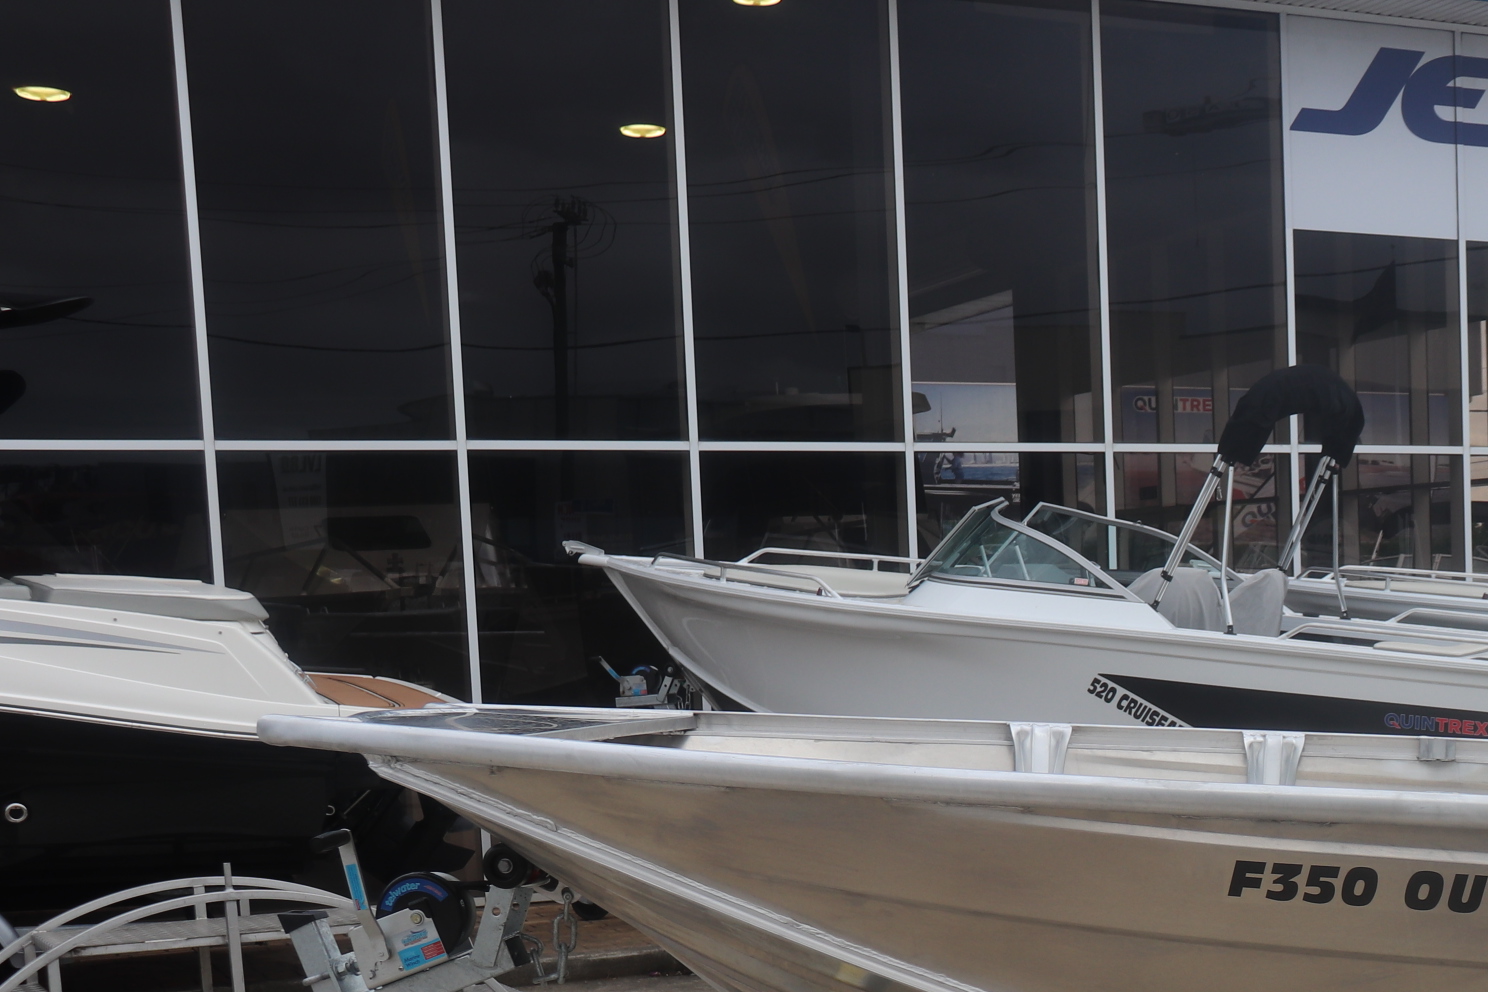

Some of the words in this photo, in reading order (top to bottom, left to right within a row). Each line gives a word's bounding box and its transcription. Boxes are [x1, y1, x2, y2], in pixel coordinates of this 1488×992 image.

[1087, 677, 1117, 703] 520
[1116, 693, 1188, 727] CRUISE
[1384, 712, 1488, 737] QUINTREX
[1227, 860, 1379, 907] F350
